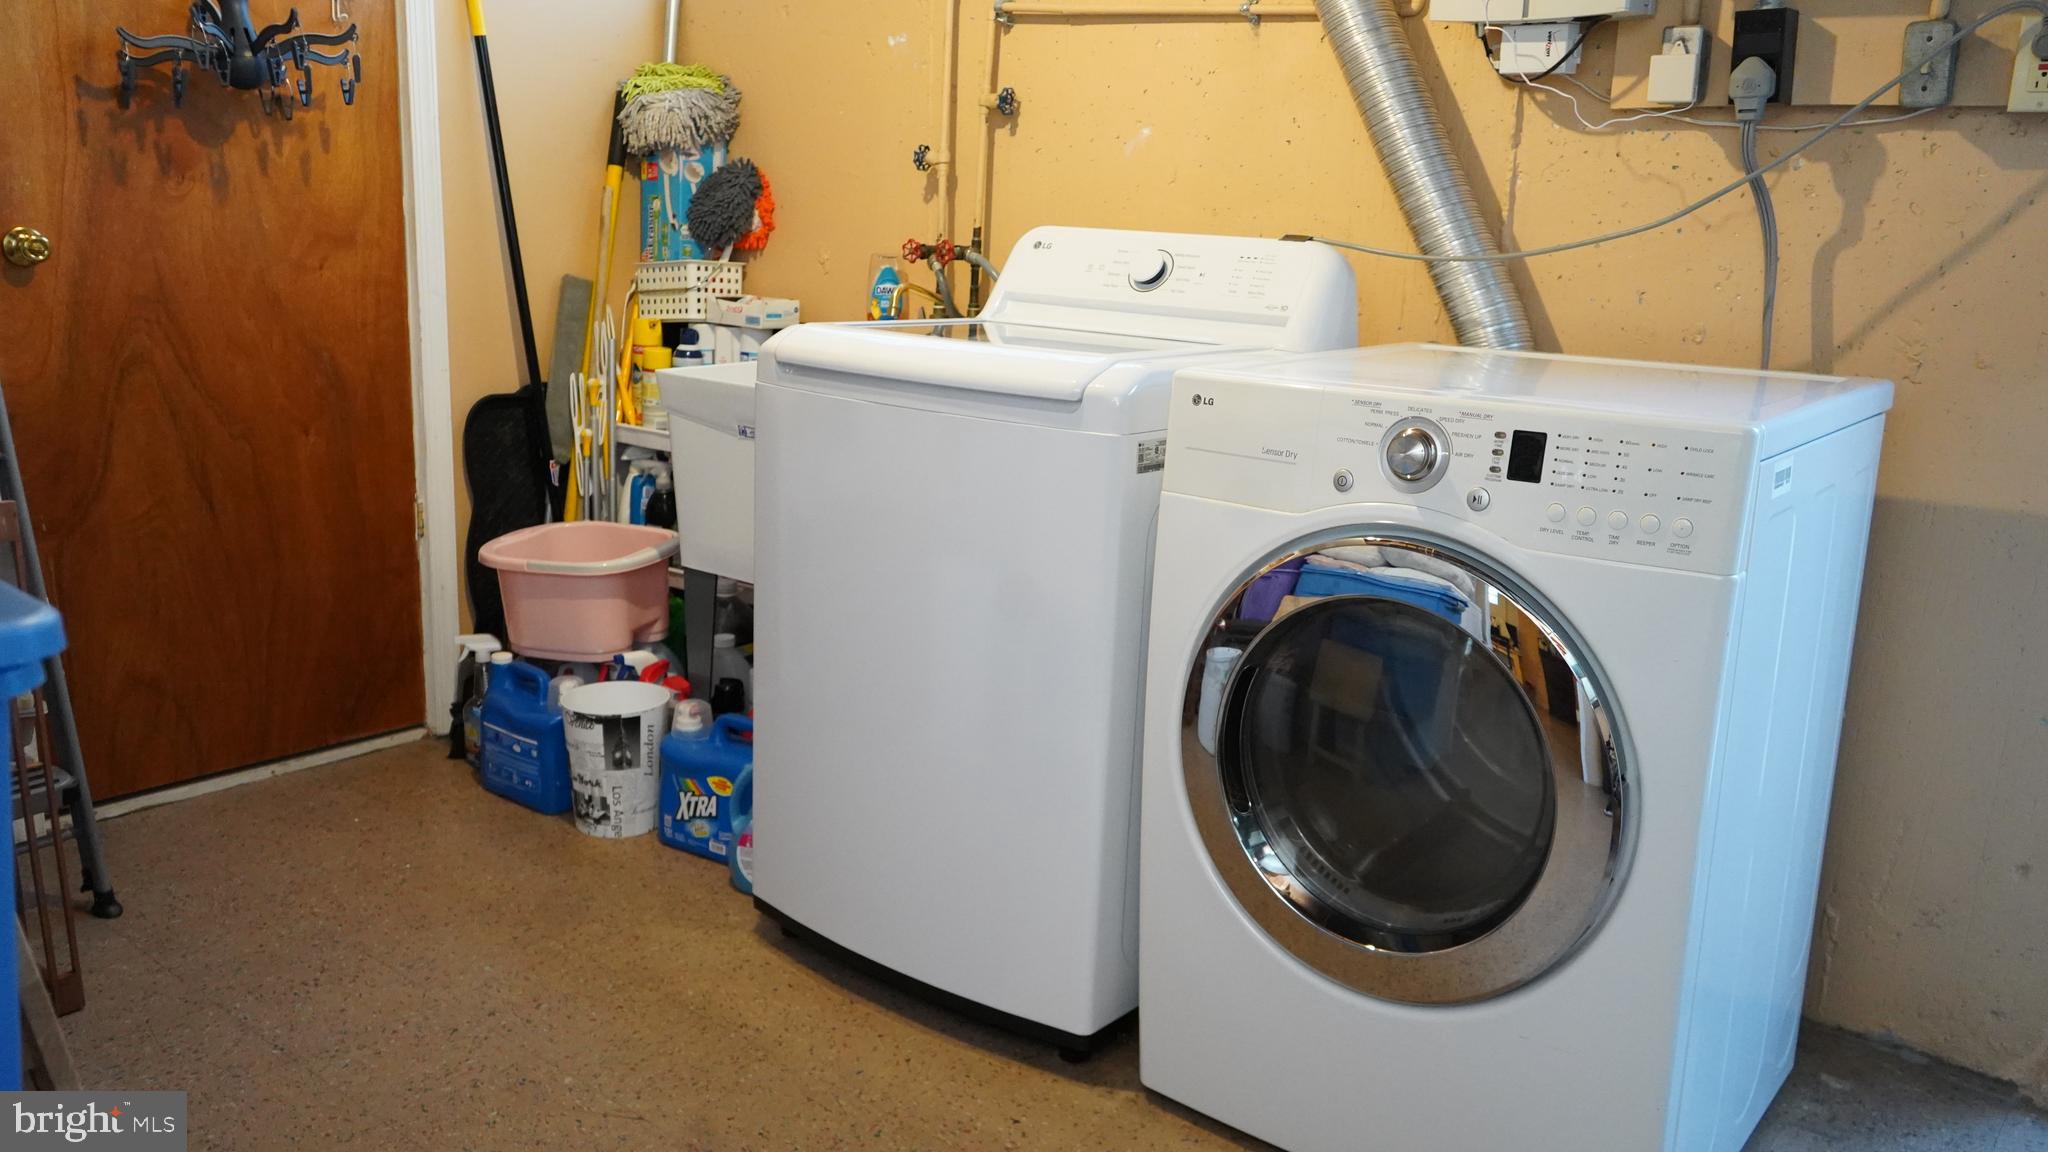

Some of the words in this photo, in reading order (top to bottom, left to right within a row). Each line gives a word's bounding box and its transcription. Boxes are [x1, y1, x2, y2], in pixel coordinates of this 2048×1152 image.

[1041, 242, 1053, 250] LG
[1203, 397, 1215, 406] LG
[1407, 406, 1433, 414] DELICATES
[1364, 421, 1384, 429] NORMAL
[1451, 431, 1475, 439] FRESHEN
[1261, 446, 1284, 457] Sensor
[1285, 449, 1298, 461] Dry
[1570, 535, 1594, 543] CONTROL
[643, 724, 655, 777] London
[611, 785, 623, 807] Los
[675, 791, 717, 821] XTRA
